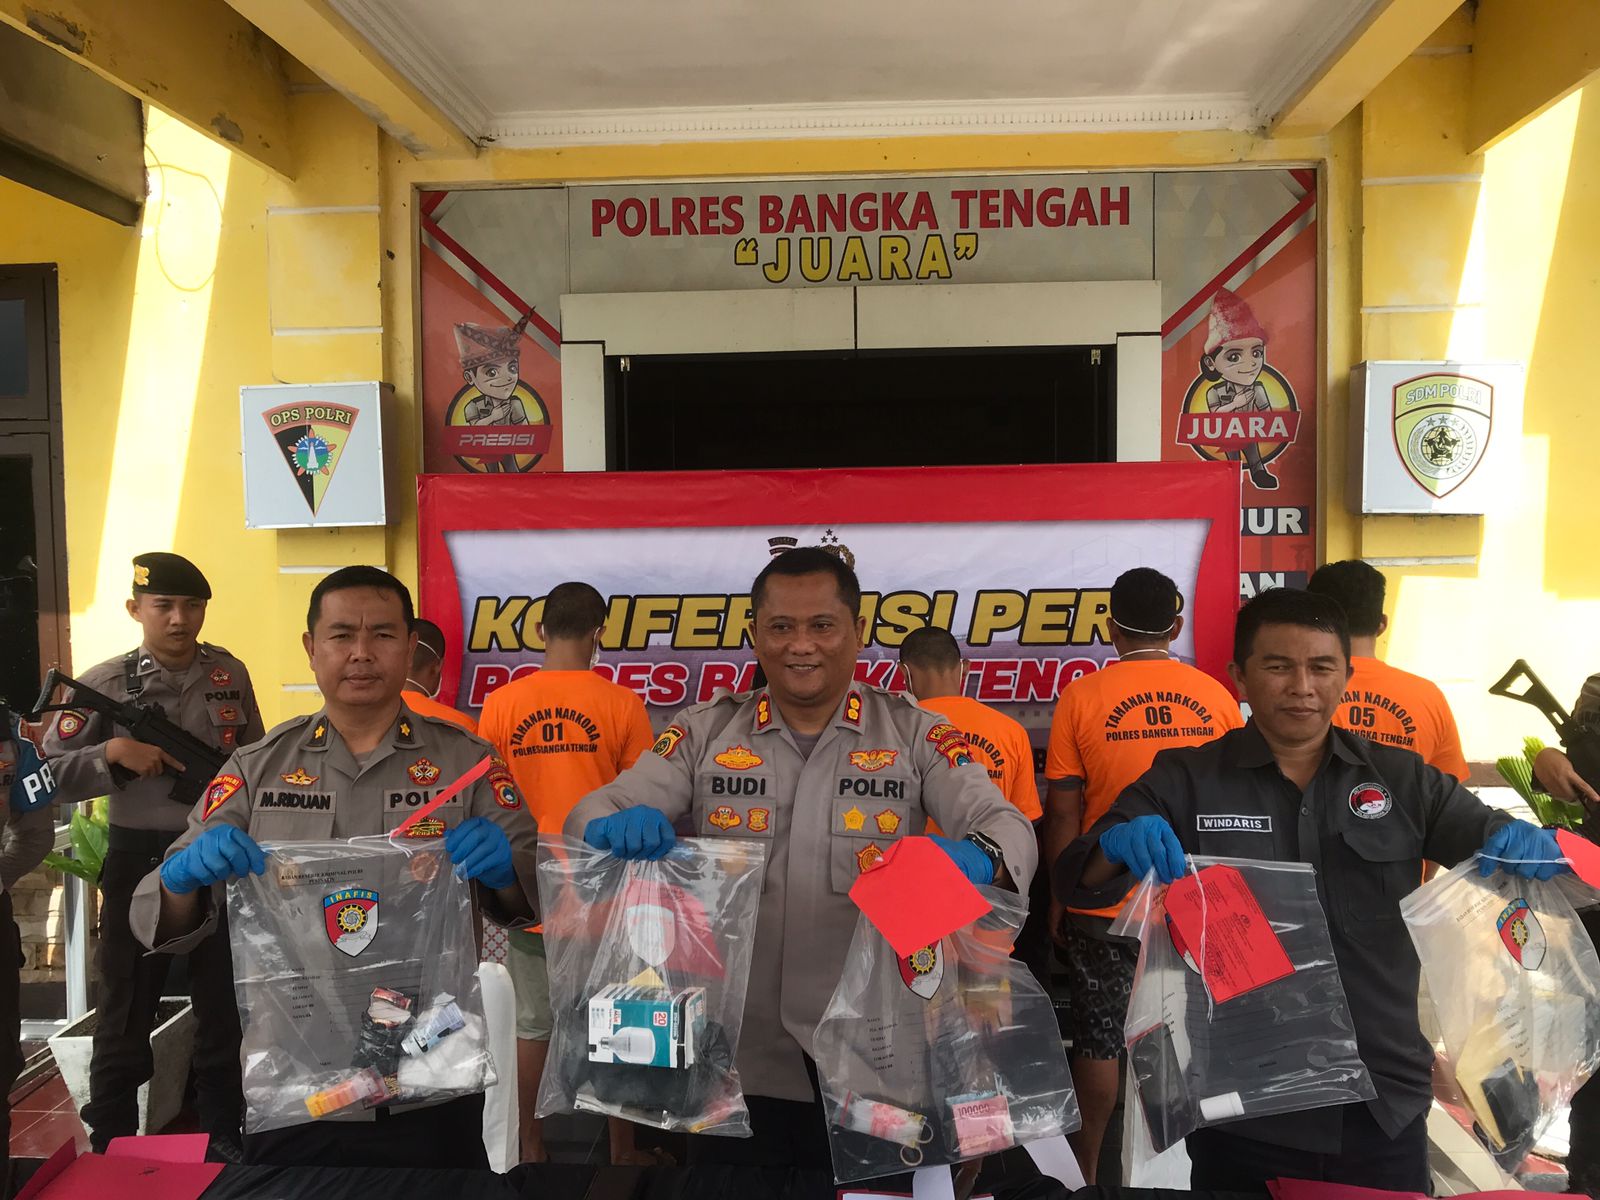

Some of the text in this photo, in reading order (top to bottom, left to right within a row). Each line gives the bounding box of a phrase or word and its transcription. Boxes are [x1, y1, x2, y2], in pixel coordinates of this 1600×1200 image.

[592, 186, 1131, 237] POLRES BANGKA TENGAH
[1405, 383, 1482, 405] SDM POLRI
[270, 406, 352, 427] OPS POLRI
[1187, 415, 1289, 440] JUARA
[458, 433, 535, 447] PRESISI
[1241, 507, 1303, 535] UR
[966, 588, 1185, 648] PER
[1105, 691, 1153, 730] TAHANAN
[1156, 691, 1213, 724] NARKOBA
[1145, 706, 1173, 726] 06
[1349, 705, 1375, 727] 05
[1364, 691, 1417, 735] NARKOBA
[510, 707, 600, 746] TAHANAN NARKOBA
[542, 722, 563, 742] 01
[1106, 727, 1214, 742] POLRES BANGKA TENGAH
[1345, 728, 1414, 746] ANGKA TENGAH
[964, 732, 1005, 768] ARKOBA
[711, 776, 766, 796] BUDI
[839, 778, 905, 799] POLRI
[260, 791, 331, 810] M.RIDUAN
[1203, 818, 1262, 829] WINDARIS
[329, 891, 373, 903] INAFIS
[658, 1013, 666, 1025] 20
